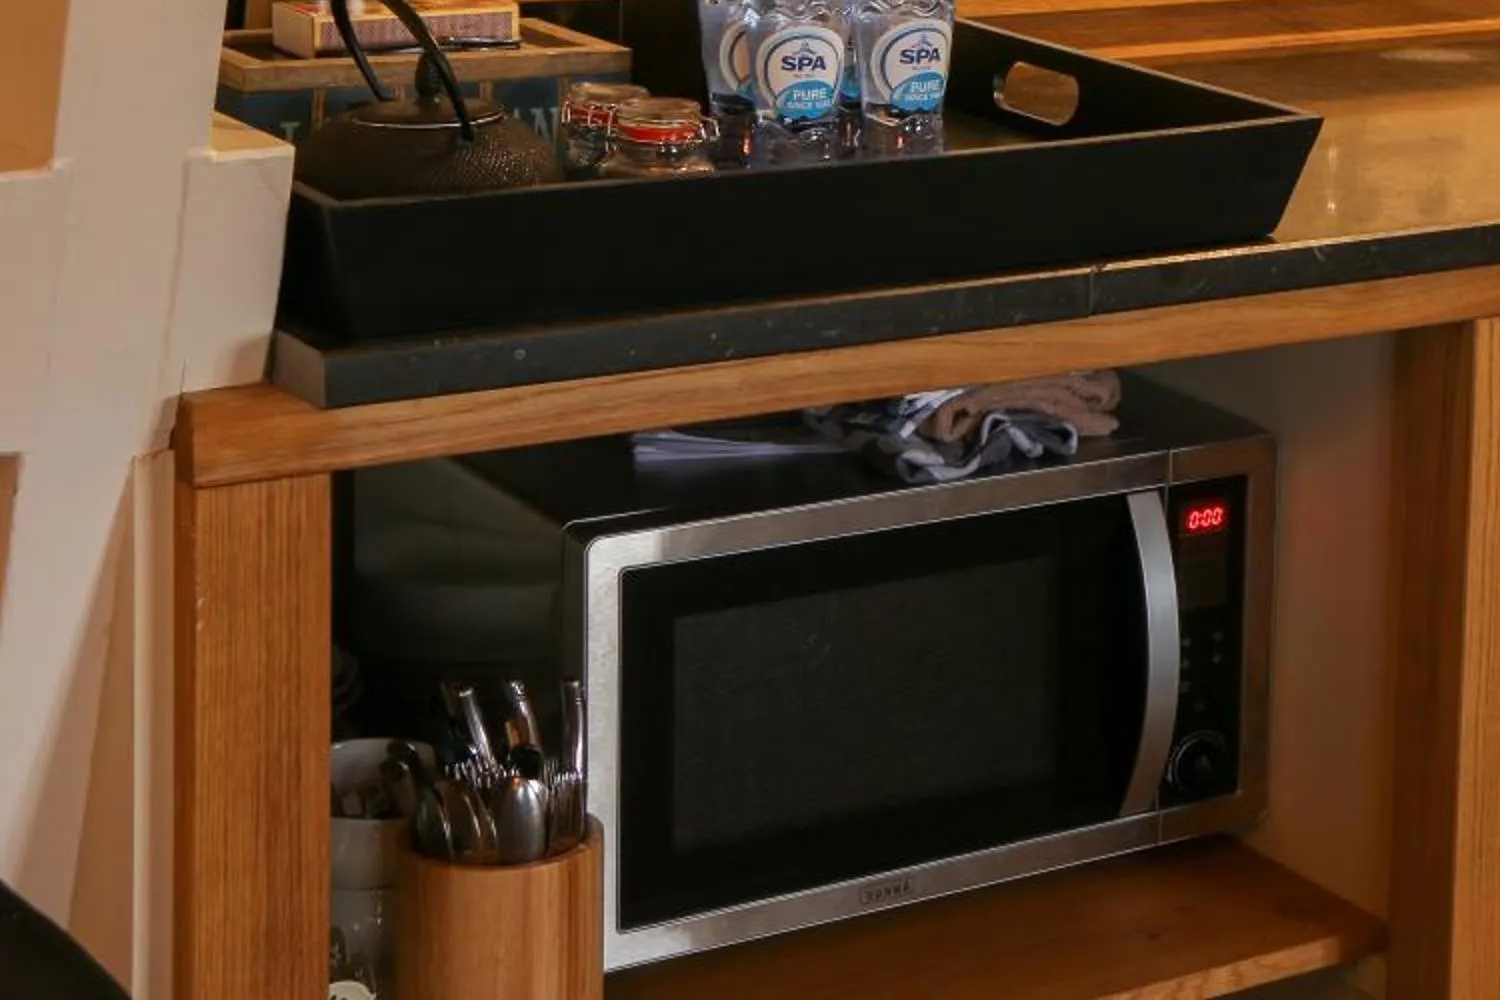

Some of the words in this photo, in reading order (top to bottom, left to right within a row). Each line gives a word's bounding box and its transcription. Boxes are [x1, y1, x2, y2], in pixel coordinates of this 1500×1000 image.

[781, 55, 826, 70] SPA
[899, 48, 940, 64] SPA
[793, 87, 827, 100] PURE
[911, 80, 942, 92] PURE
[1189, 507, 1222, 529] 0:00
